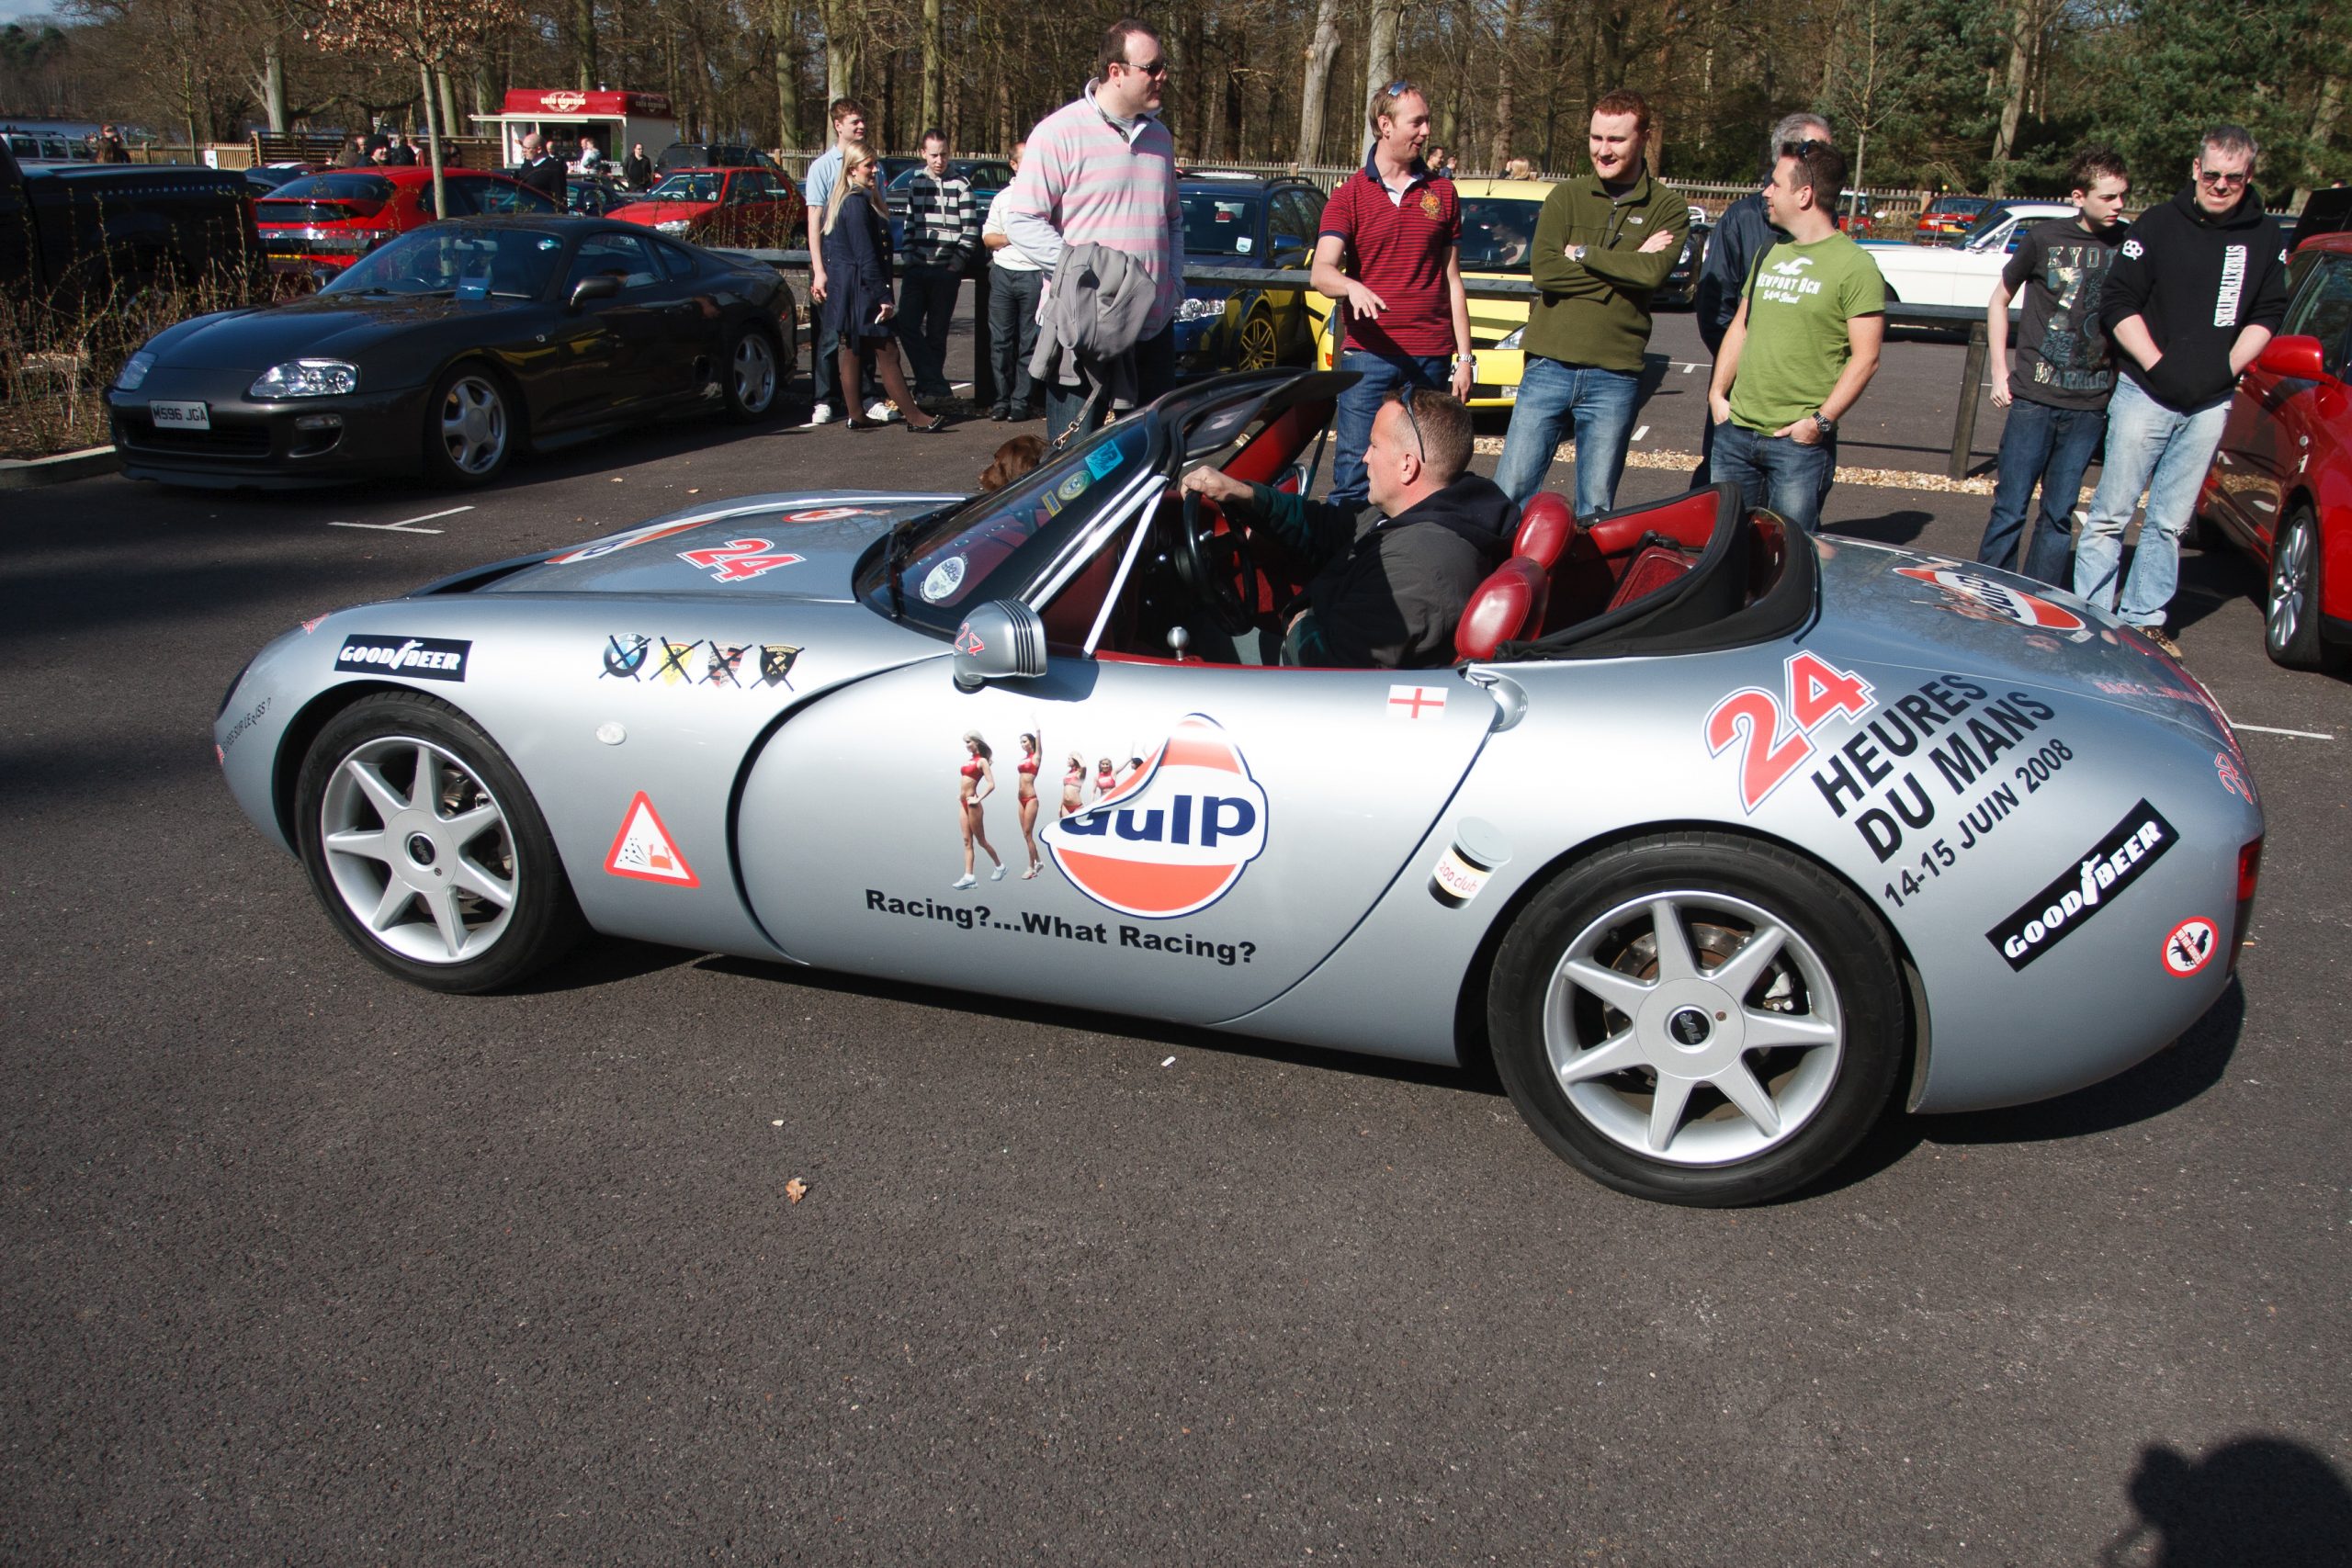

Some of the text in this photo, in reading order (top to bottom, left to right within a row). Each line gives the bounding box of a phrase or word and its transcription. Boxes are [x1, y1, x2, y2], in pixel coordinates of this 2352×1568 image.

[2213, 245, 2246, 326] STREETFIGHTERS
[153, 405, 208, 422] M596 JGA
[676, 538, 807, 582] 24
[339, 646, 461, 671] GOOD BEER
[954, 622, 985, 656] 24
[1702, 649, 1879, 817] 24
[1811, 674, 1988, 818] HEURES
[1854, 691, 2056, 863] DU MANS
[1884, 739, 2074, 908] 14-15 JUIN 2008
[1453, 875, 1477, 892] club
[2004, 820, 2163, 958] GOOD BEER
[1119, 924, 1257, 966] Racing?
